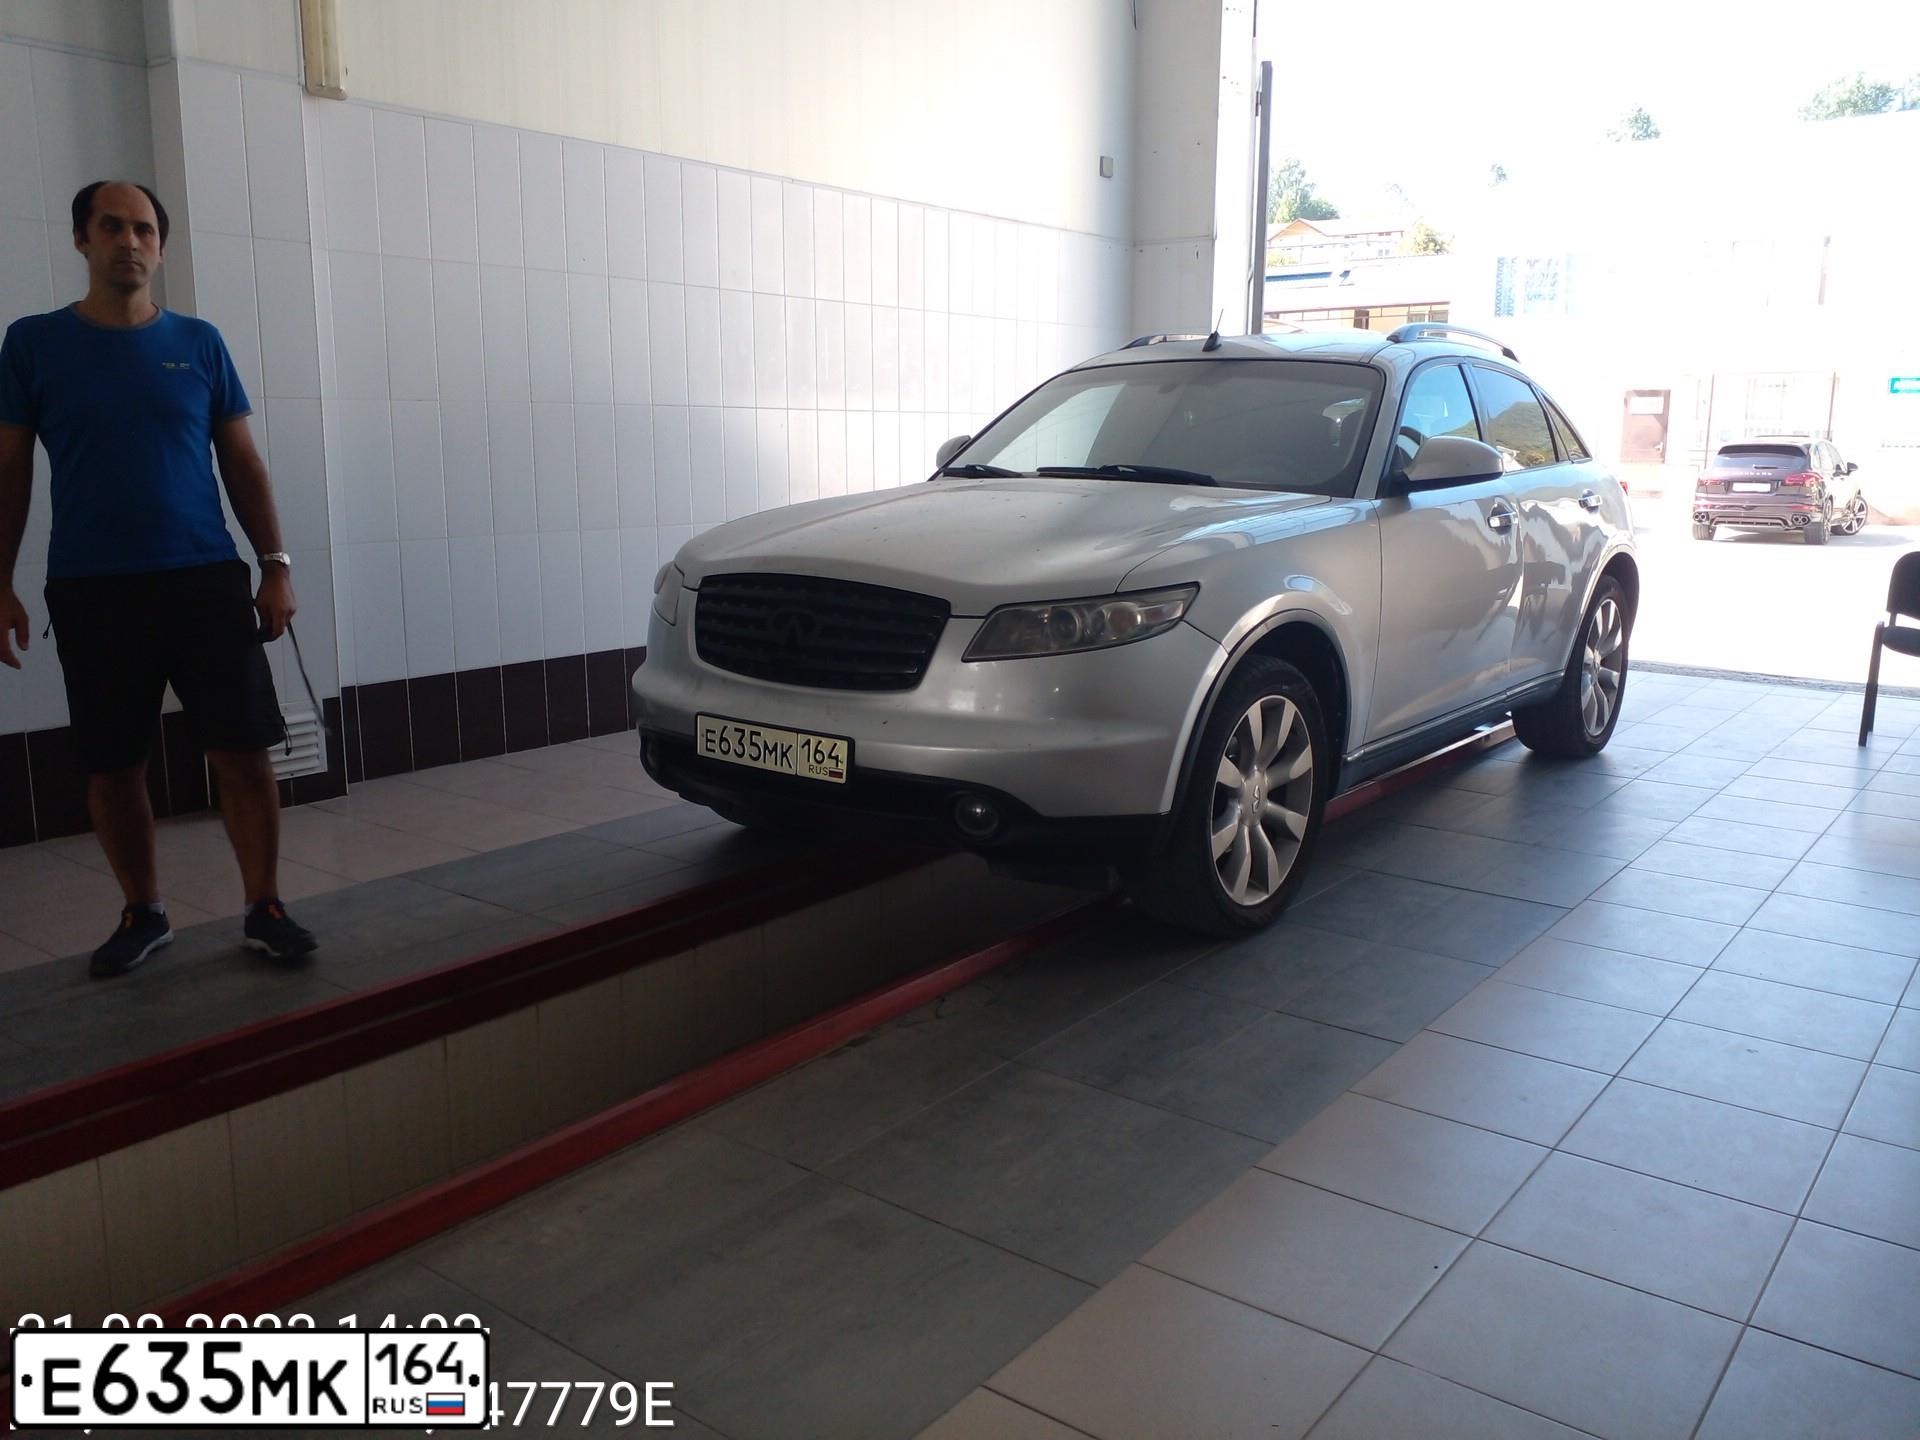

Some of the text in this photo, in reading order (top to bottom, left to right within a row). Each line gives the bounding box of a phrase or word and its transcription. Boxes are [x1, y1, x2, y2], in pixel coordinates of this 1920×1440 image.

[705, 725, 840, 769] E635MK 164
[808, 764, 829, 776] RUS
